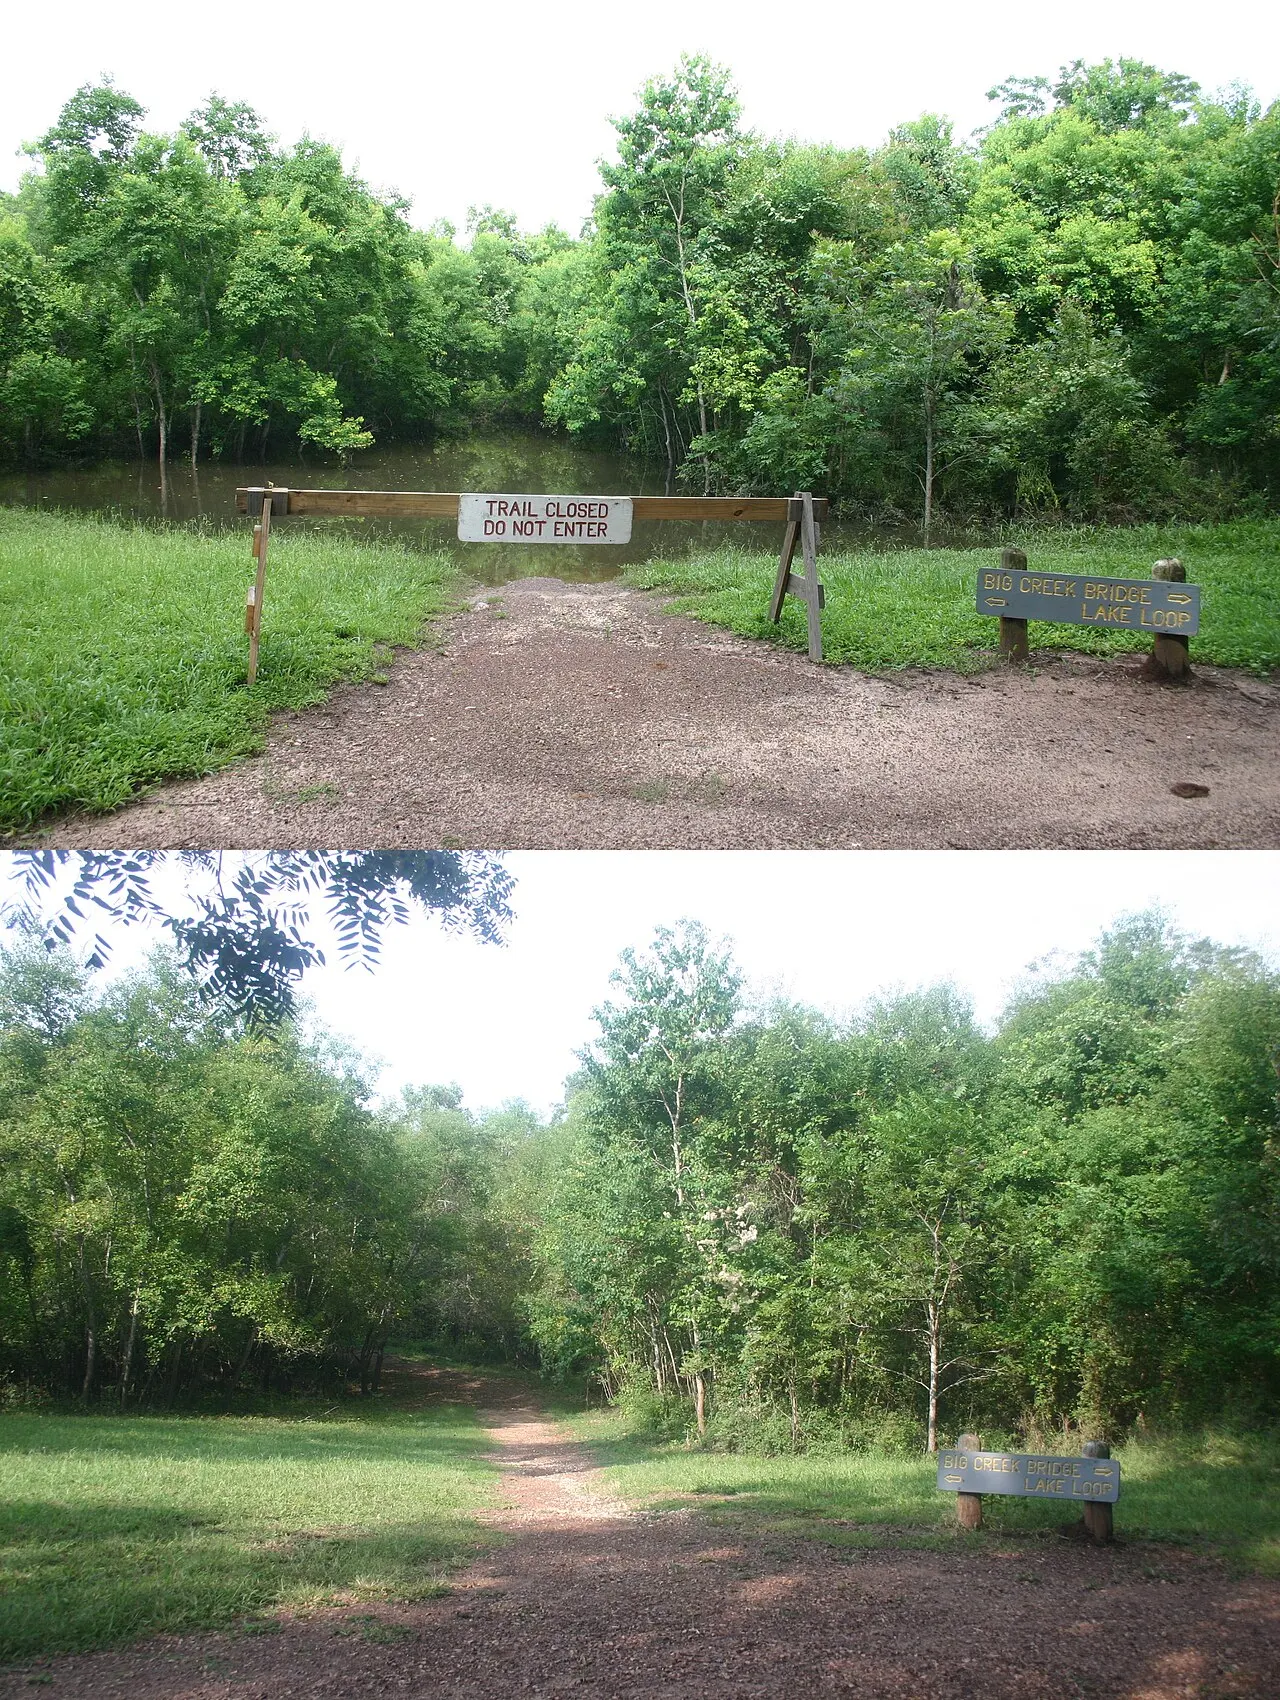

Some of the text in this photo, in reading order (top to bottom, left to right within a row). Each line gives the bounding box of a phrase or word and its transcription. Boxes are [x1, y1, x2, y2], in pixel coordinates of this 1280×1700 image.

[486, 500, 609, 519] TRAIL CLOSED
[483, 520, 608, 537] DO NOT ENTER
[984, 574, 1152, 605] BIG CREEK BRIDGE
[1081, 603, 1191, 628] LAKE LOOP
[943, 1455, 1082, 1478] BIG CREEK BRIDGE
[1024, 1478, 1113, 1497] LAKE LOOP
